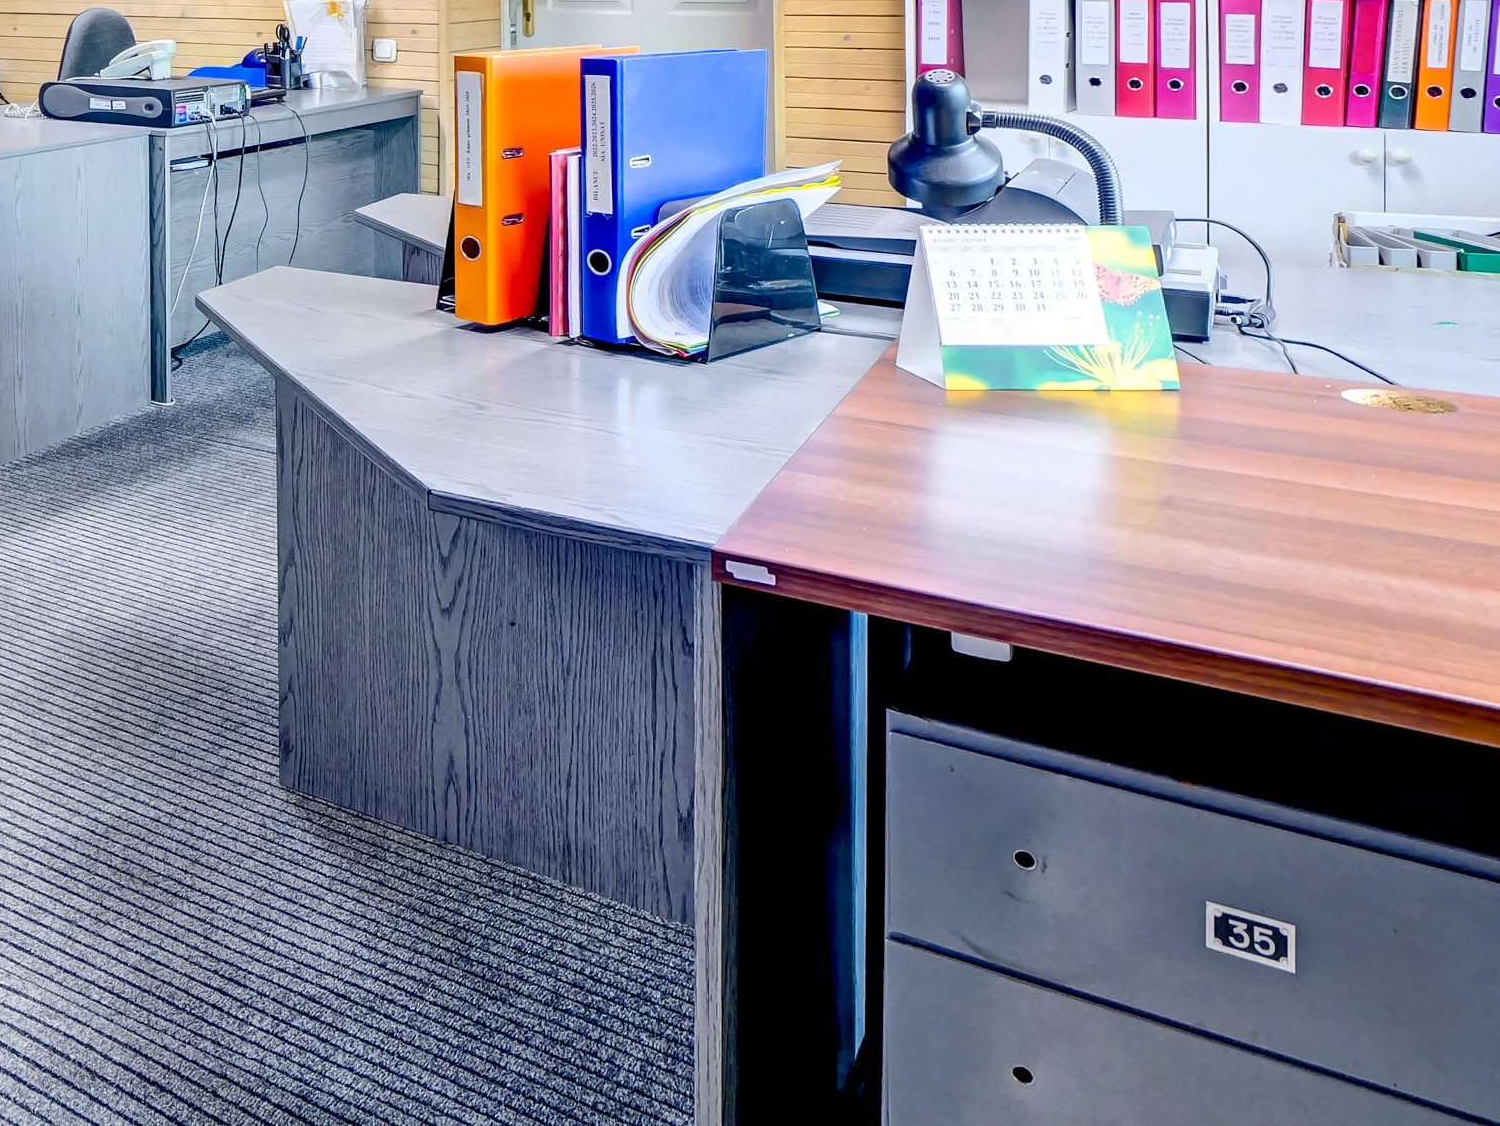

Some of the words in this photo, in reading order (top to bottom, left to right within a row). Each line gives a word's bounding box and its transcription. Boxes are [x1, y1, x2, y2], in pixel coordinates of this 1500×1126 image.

[949, 269, 955, 277] 6
[969, 269, 976, 277] 7
[991, 269, 998, 277] 8
[1012, 269, 1018, 277] 9
[1028, 269, 1040, 277] 10
[947, 292, 959, 300] 20
[969, 292, 979, 300] 21
[990, 292, 1001, 300] 22
[1010, 292, 1023, 300] 23
[1032, 292, 1044, 300] 24
[949, 304, 960, 312] 27
[970, 304, 983, 312] 28
[992, 304, 1004, 312] 29
[1013, 303, 1025, 312] 30
[1035, 303, 1046, 311] 31
[1228, 919, 1275, 956] 35
